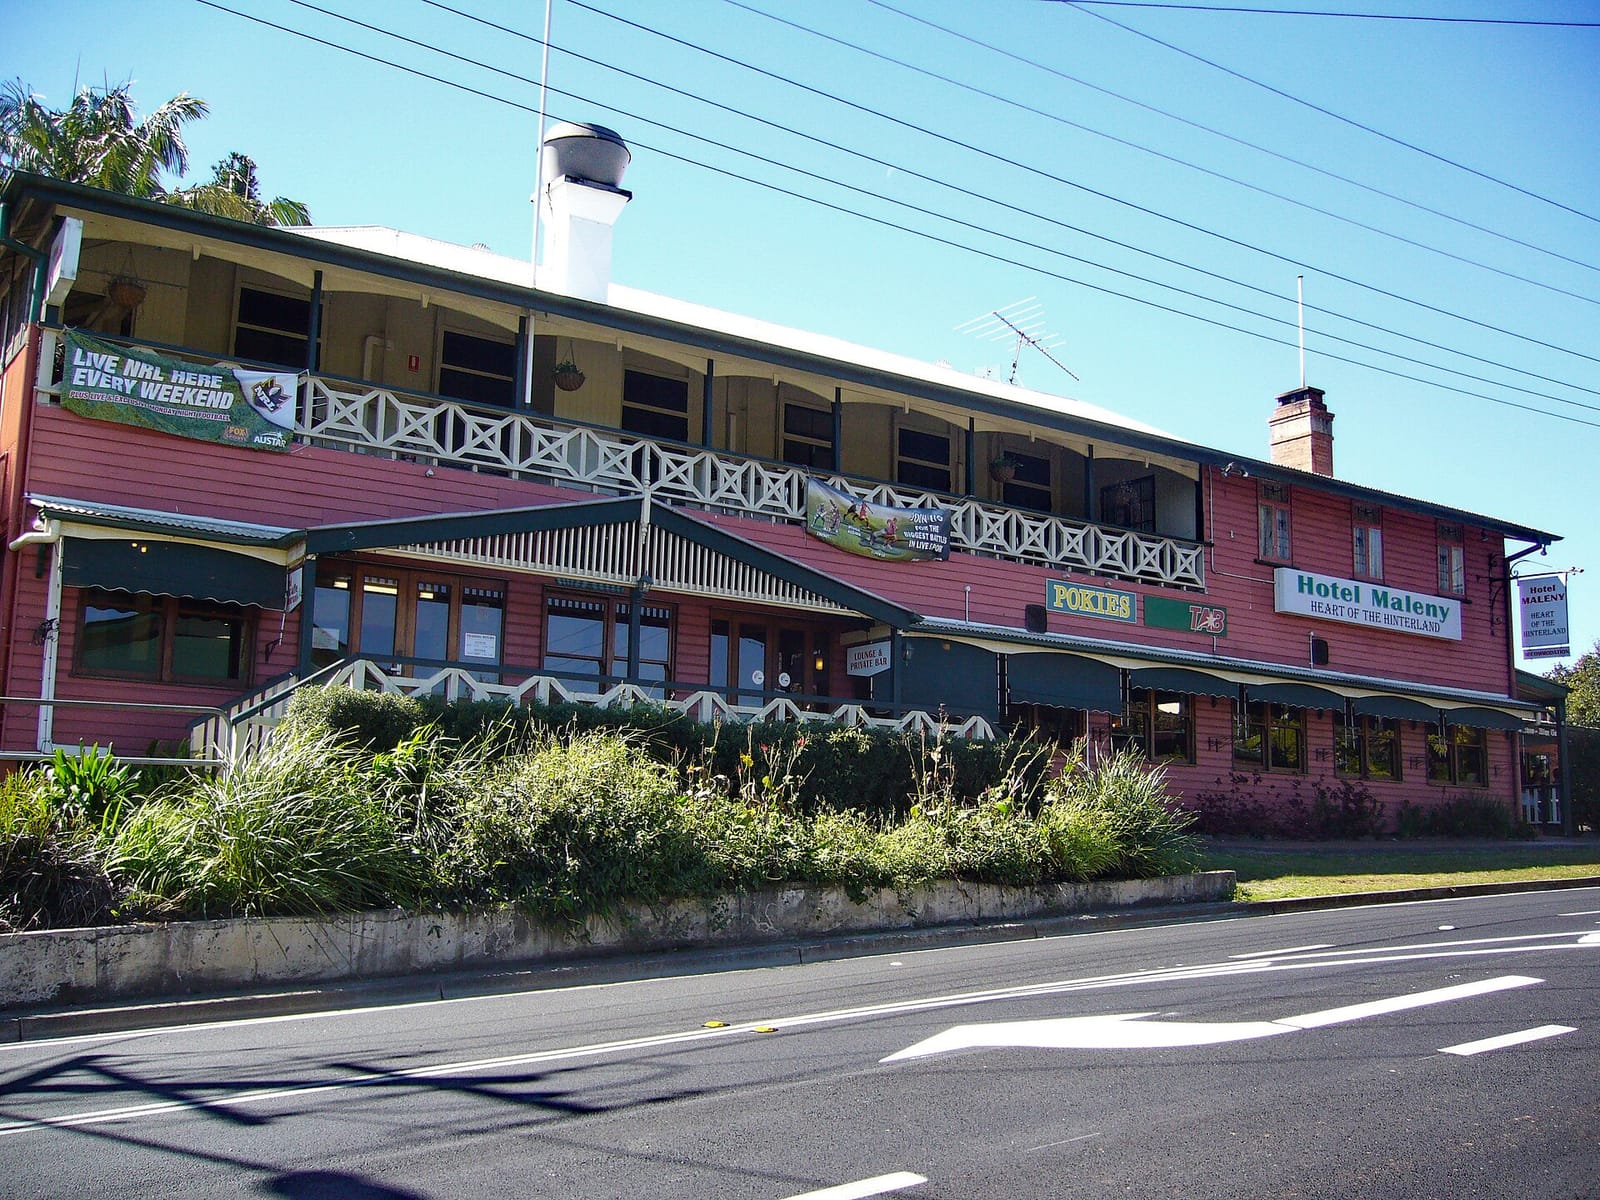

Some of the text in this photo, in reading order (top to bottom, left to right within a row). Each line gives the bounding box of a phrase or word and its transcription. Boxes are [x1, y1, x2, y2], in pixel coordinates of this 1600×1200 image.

[73, 348, 223, 389] LIVE NRL HERE
[73, 367, 235, 410] EVERY WEEKEND
[70, 390, 89, 399] PLUS
[90, 392, 106, 401] LIVE
[114, 395, 148, 408] EXCLUSIV
[255, 385, 276, 411] NRL
[254, 435, 286, 447] AUSTAR
[910, 512, 928, 524] JOIN
[908, 540, 916, 548] IN
[916, 540, 930, 550] LIVE
[1530, 584, 1556, 594] Hotel
[1053, 584, 1131, 619] POKIES
[1297, 574, 1450, 623] Hotel Maleny
[1521, 593, 1565, 605] MALENY
[1189, 605, 1225, 634] TAB
[1311, 600, 1440, 633] HEART OF THE HINTERLAND
[1530, 610, 1555, 619] HEART
[1531, 619, 1555, 628] OF THE
[854, 650, 877, 661] LOUNGE
[1524, 649, 1570, 657] COMMODATION
[850, 657, 888, 671] PRIVATE BAR
